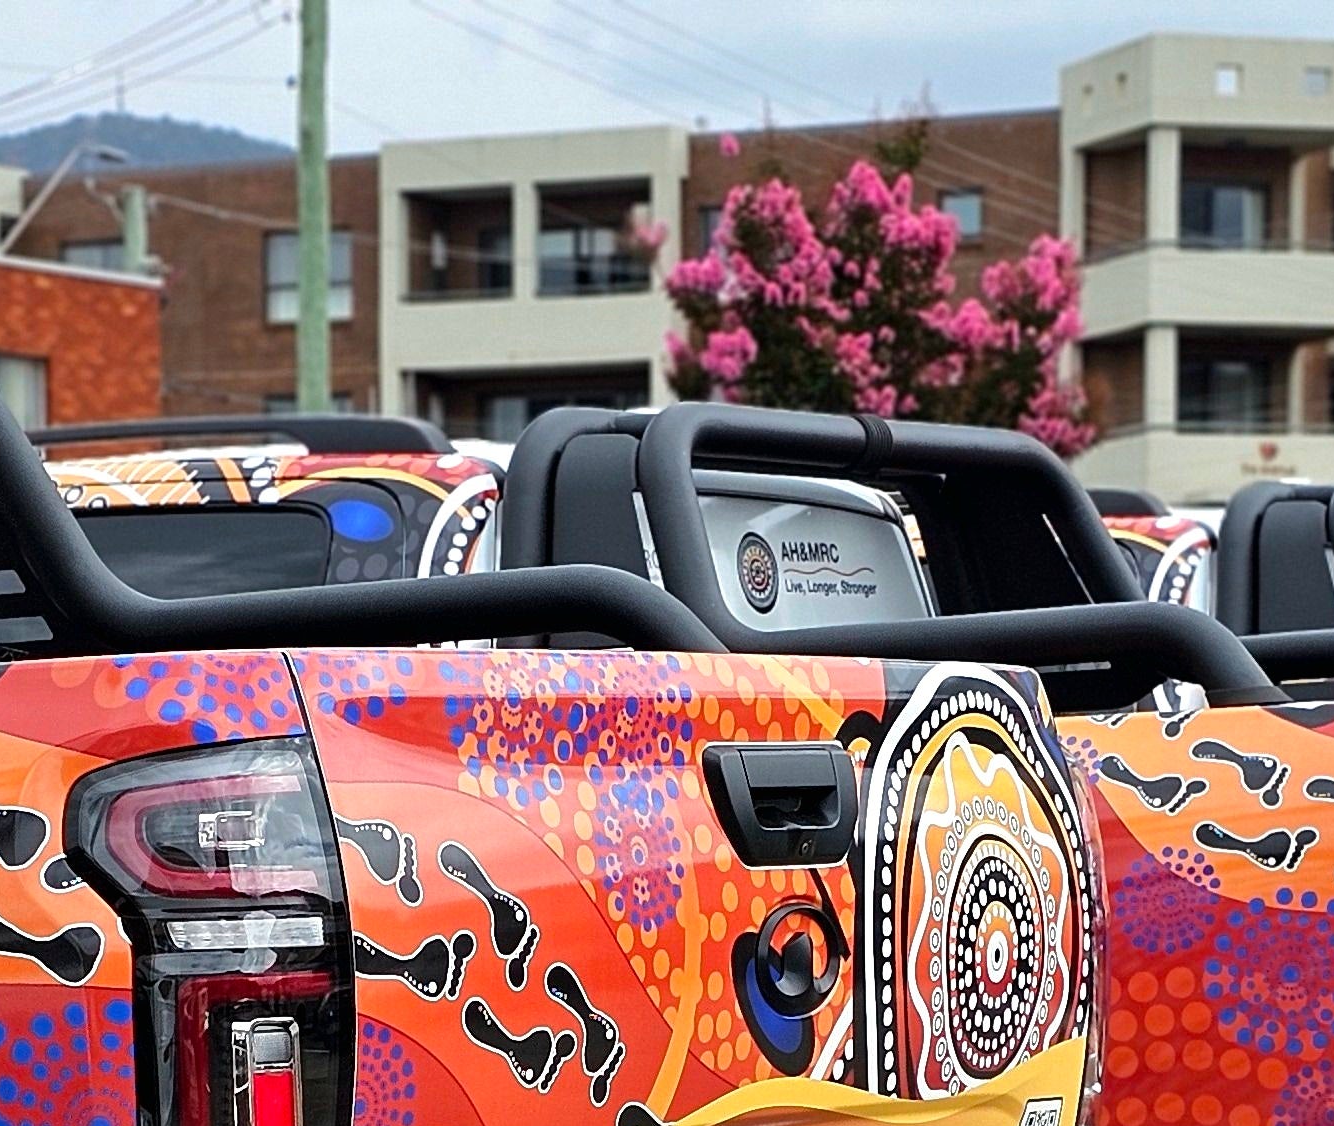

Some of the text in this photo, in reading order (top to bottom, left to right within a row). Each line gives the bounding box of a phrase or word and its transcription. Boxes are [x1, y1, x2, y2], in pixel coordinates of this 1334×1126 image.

[781, 541, 840, 564] AH&MRC
[784, 578, 877, 599] Live, Longer, Stronger
